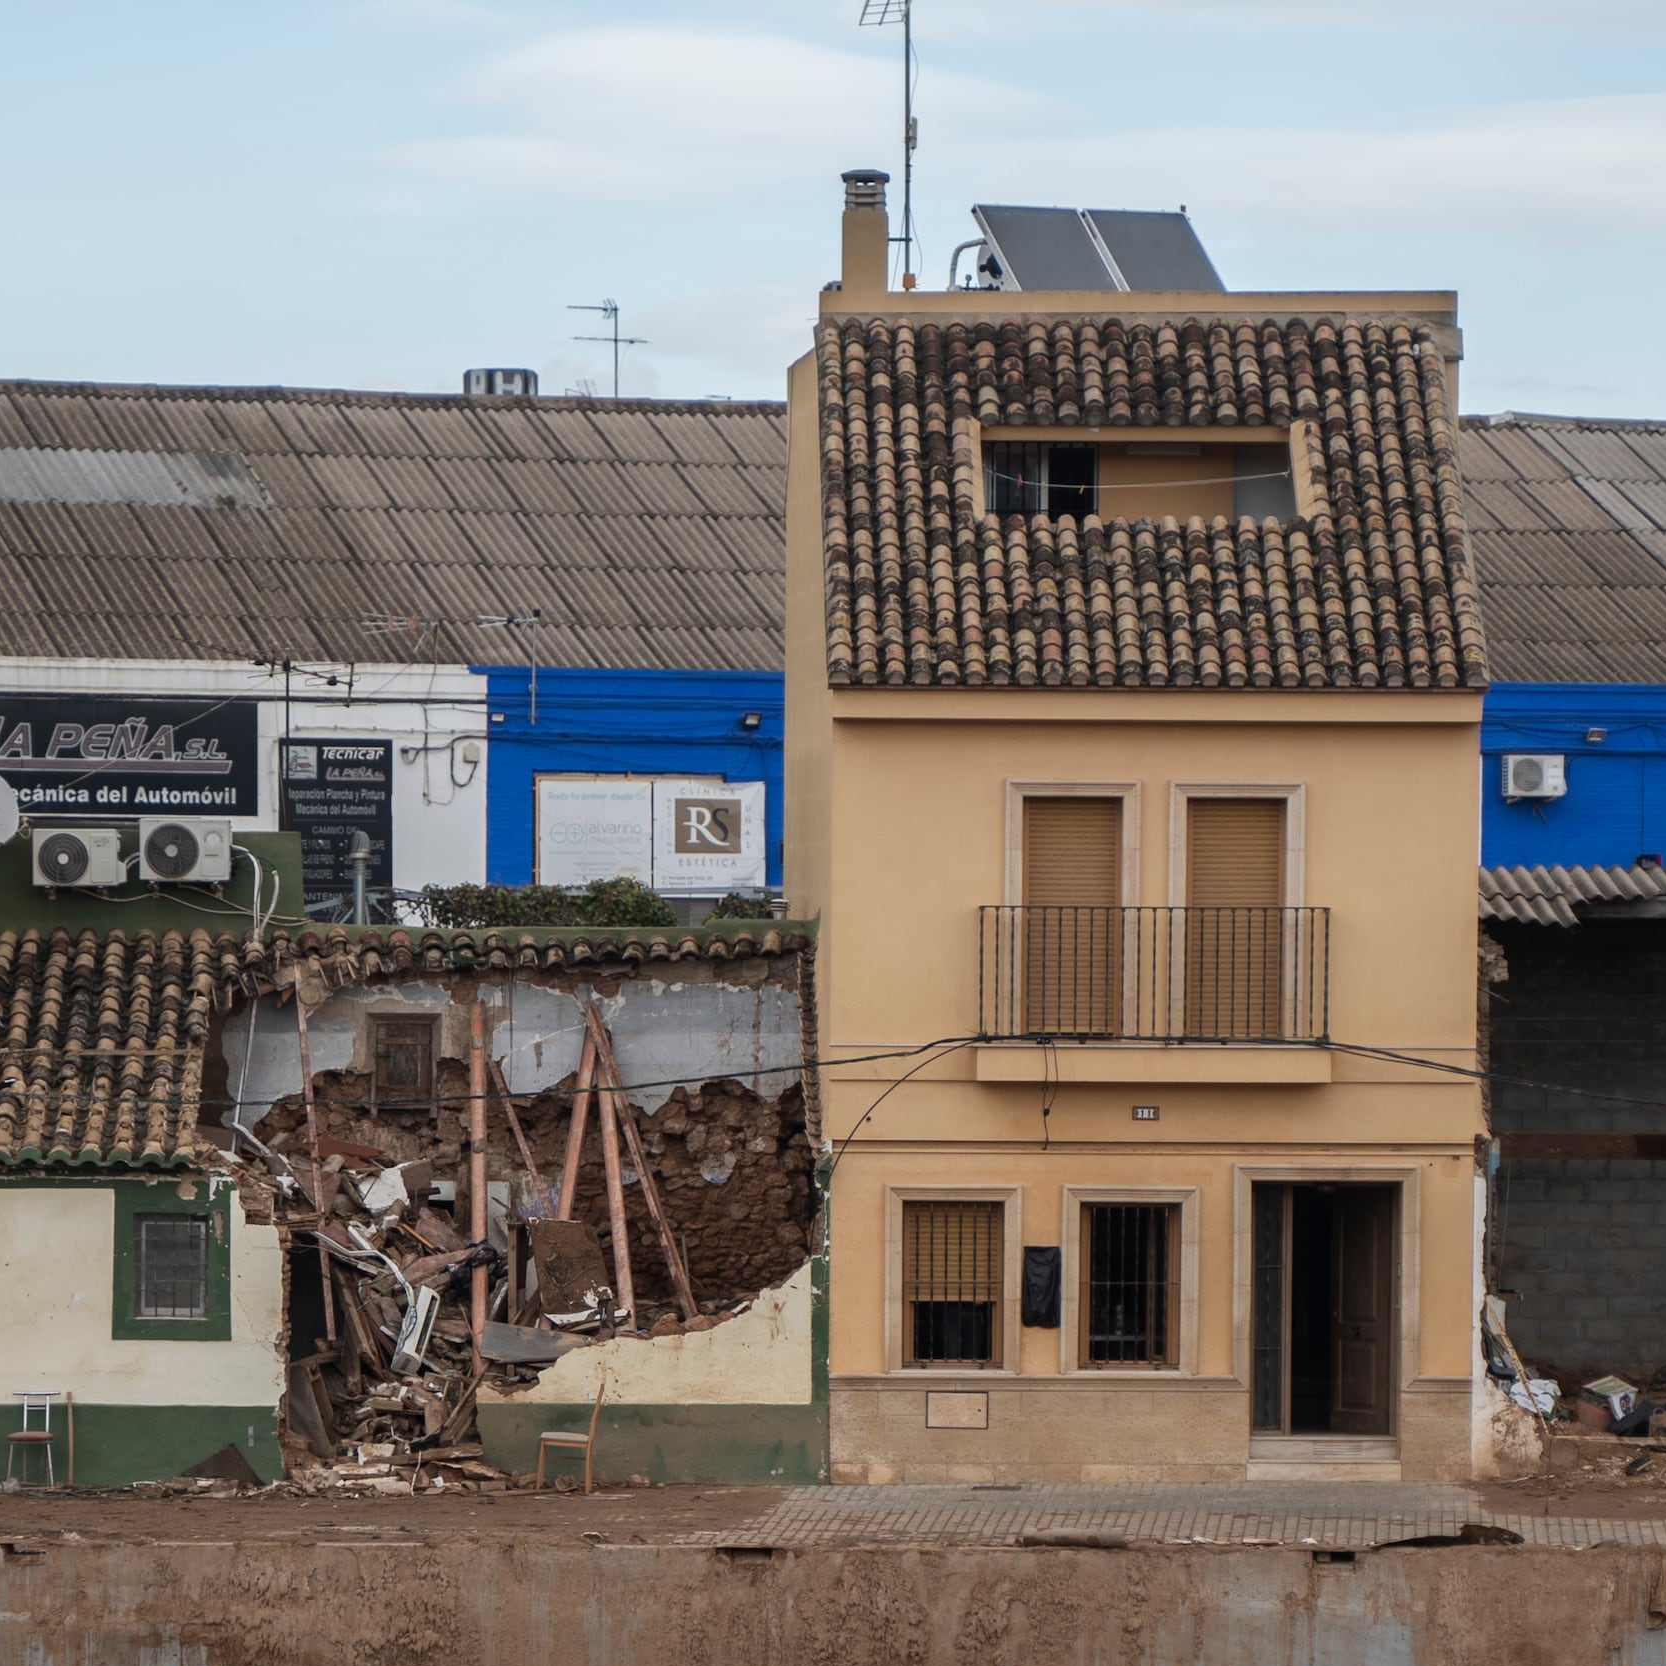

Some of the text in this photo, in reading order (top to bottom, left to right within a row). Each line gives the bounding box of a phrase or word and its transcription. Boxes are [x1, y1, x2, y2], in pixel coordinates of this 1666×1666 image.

[13, 783, 89, 803] ecánica
[96, 785, 128, 803] del
[134, 785, 237, 804] Automóvil
[326, 788, 353, 800] Plancha
[354, 791, 360, 802] y
[361, 788, 385, 800] Pintura
[296, 803, 377, 815] Mecánica del Automóvil
[312, 825, 345, 835] CAMBIO
[683, 806, 730, 846] RS
[744, 803, 752, 849] UÑAS
[678, 857, 738, 868] ESTÉTICA
